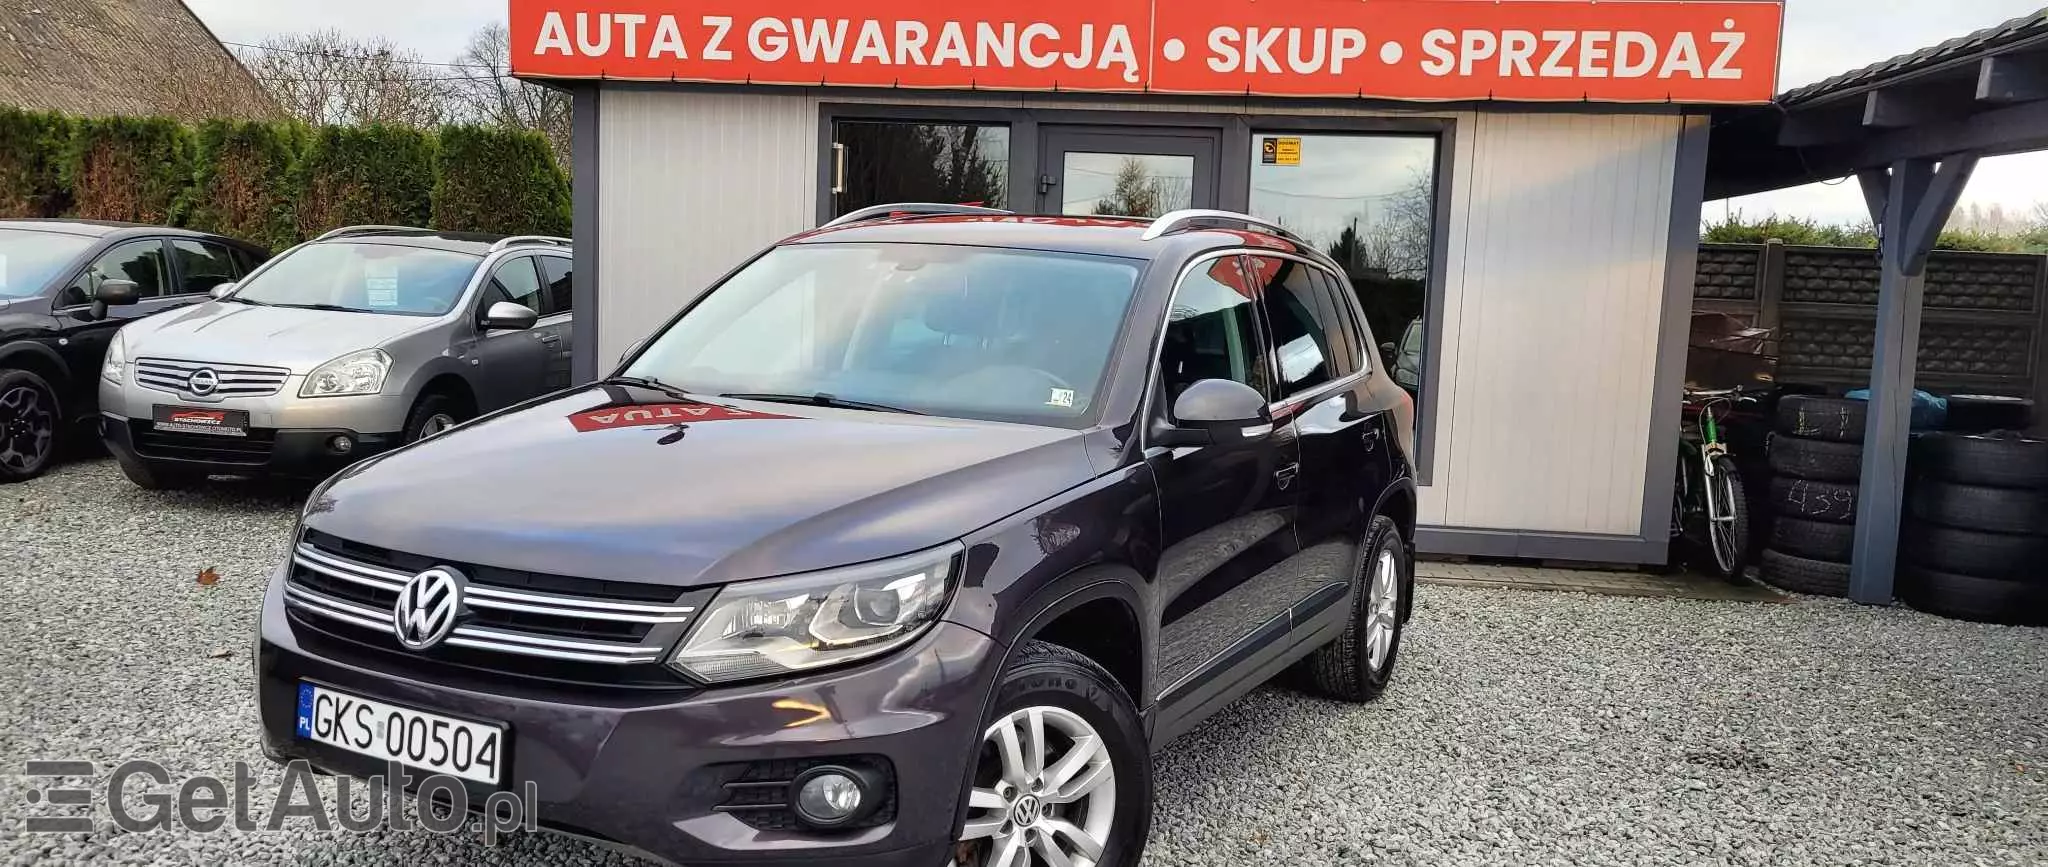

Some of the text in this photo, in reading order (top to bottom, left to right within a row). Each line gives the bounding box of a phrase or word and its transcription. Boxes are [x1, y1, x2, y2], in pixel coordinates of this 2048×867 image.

[533, 11, 1745, 83] AUTA Z GWARANCJĄ SKUP SPRZEDAŻ
[299, 716, 311, 731] PL
[315, 693, 497, 779] GKS 00504
